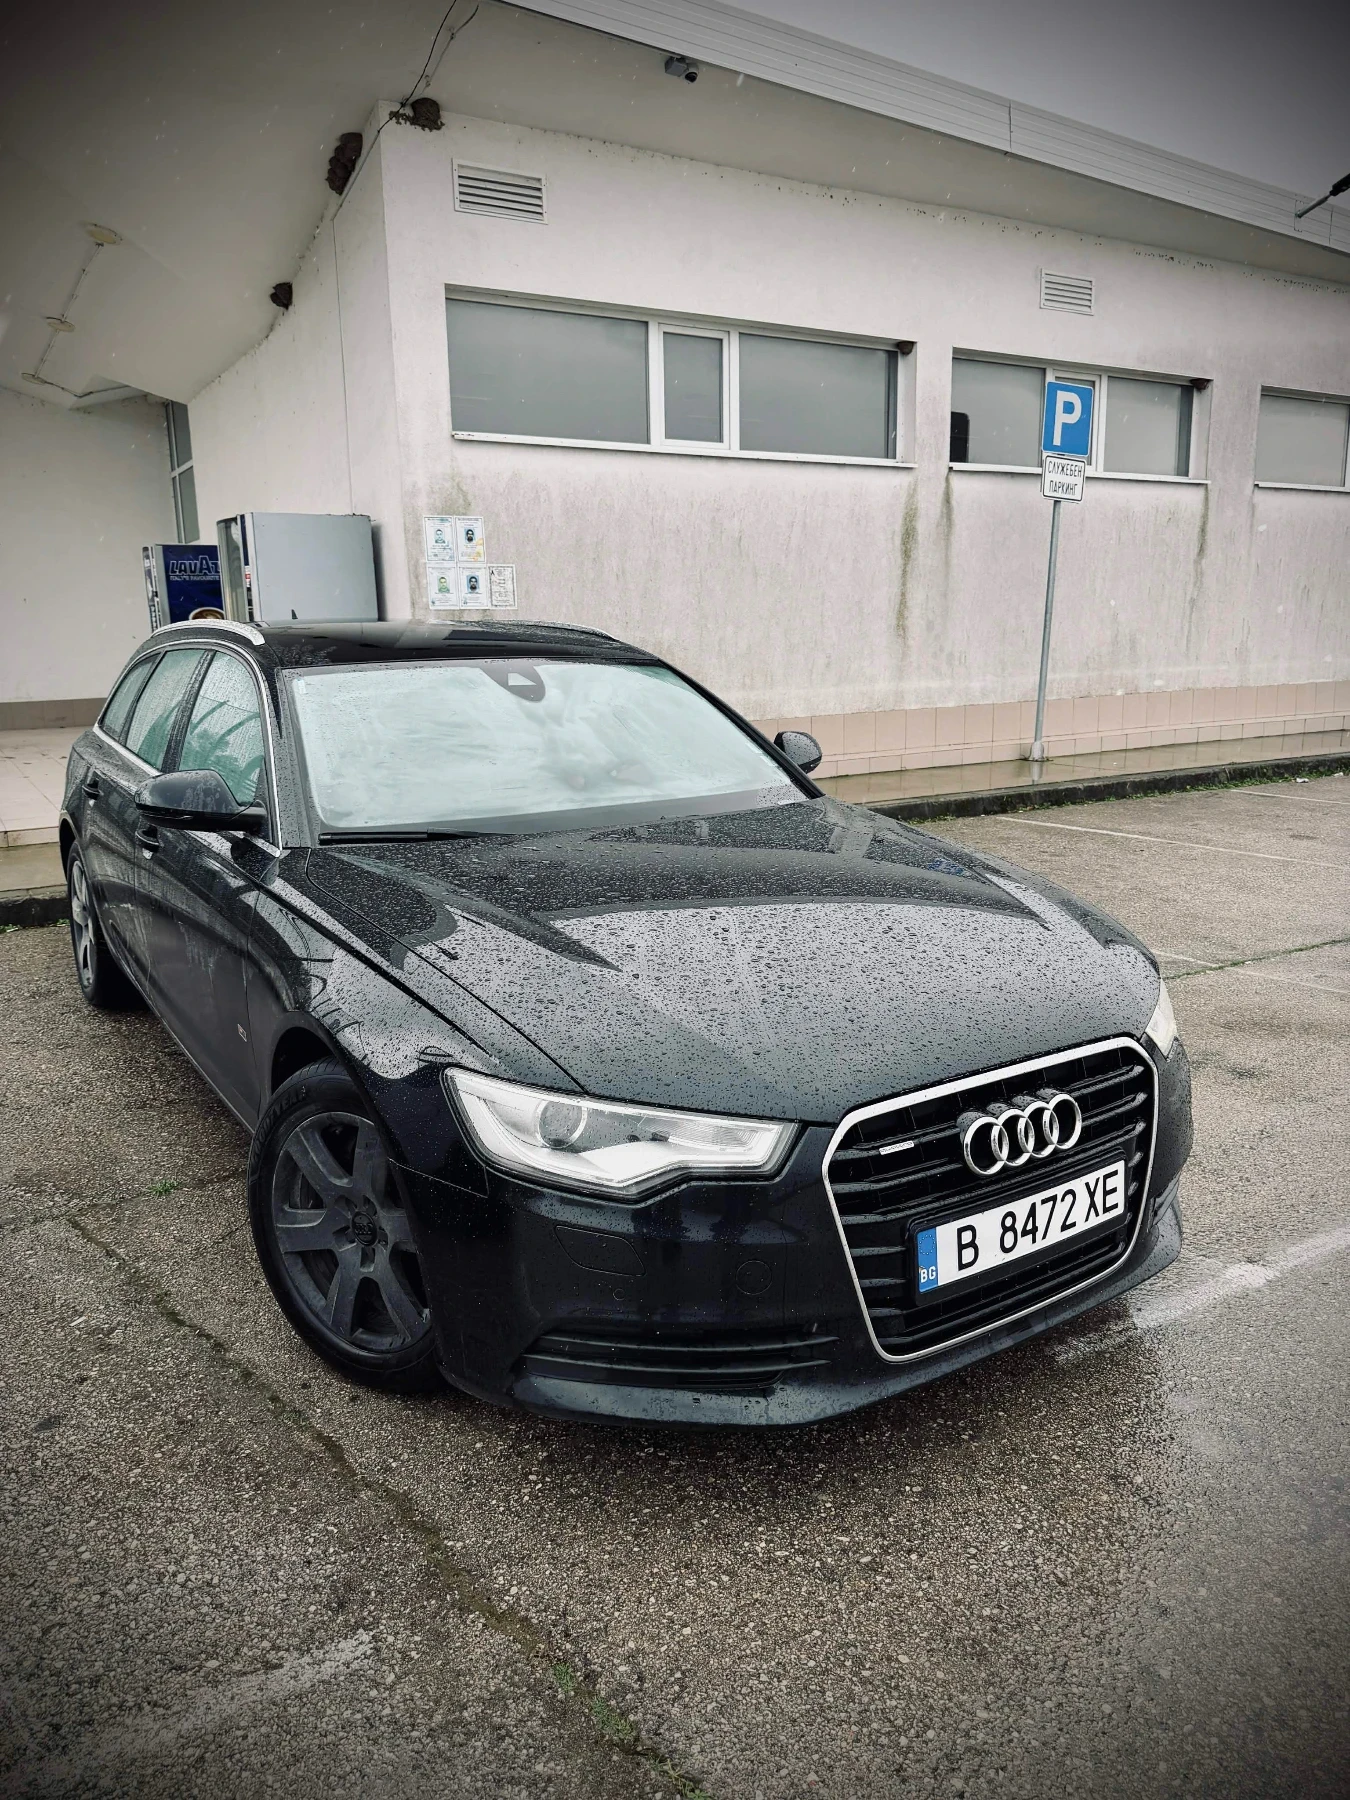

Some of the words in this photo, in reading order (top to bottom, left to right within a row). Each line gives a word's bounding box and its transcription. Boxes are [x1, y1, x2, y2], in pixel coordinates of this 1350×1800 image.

[1053, 390, 1082, 446] P
[1047, 461, 1083, 478] СЛУЖЕБЕН
[1049, 480, 1078, 496] ПАРКИНГ
[956, 1225, 980, 1271] B
[999, 1188, 1077, 1254] 8472
[1084, 1169, 1119, 1223] XE
[920, 1264, 937, 1284] BG
